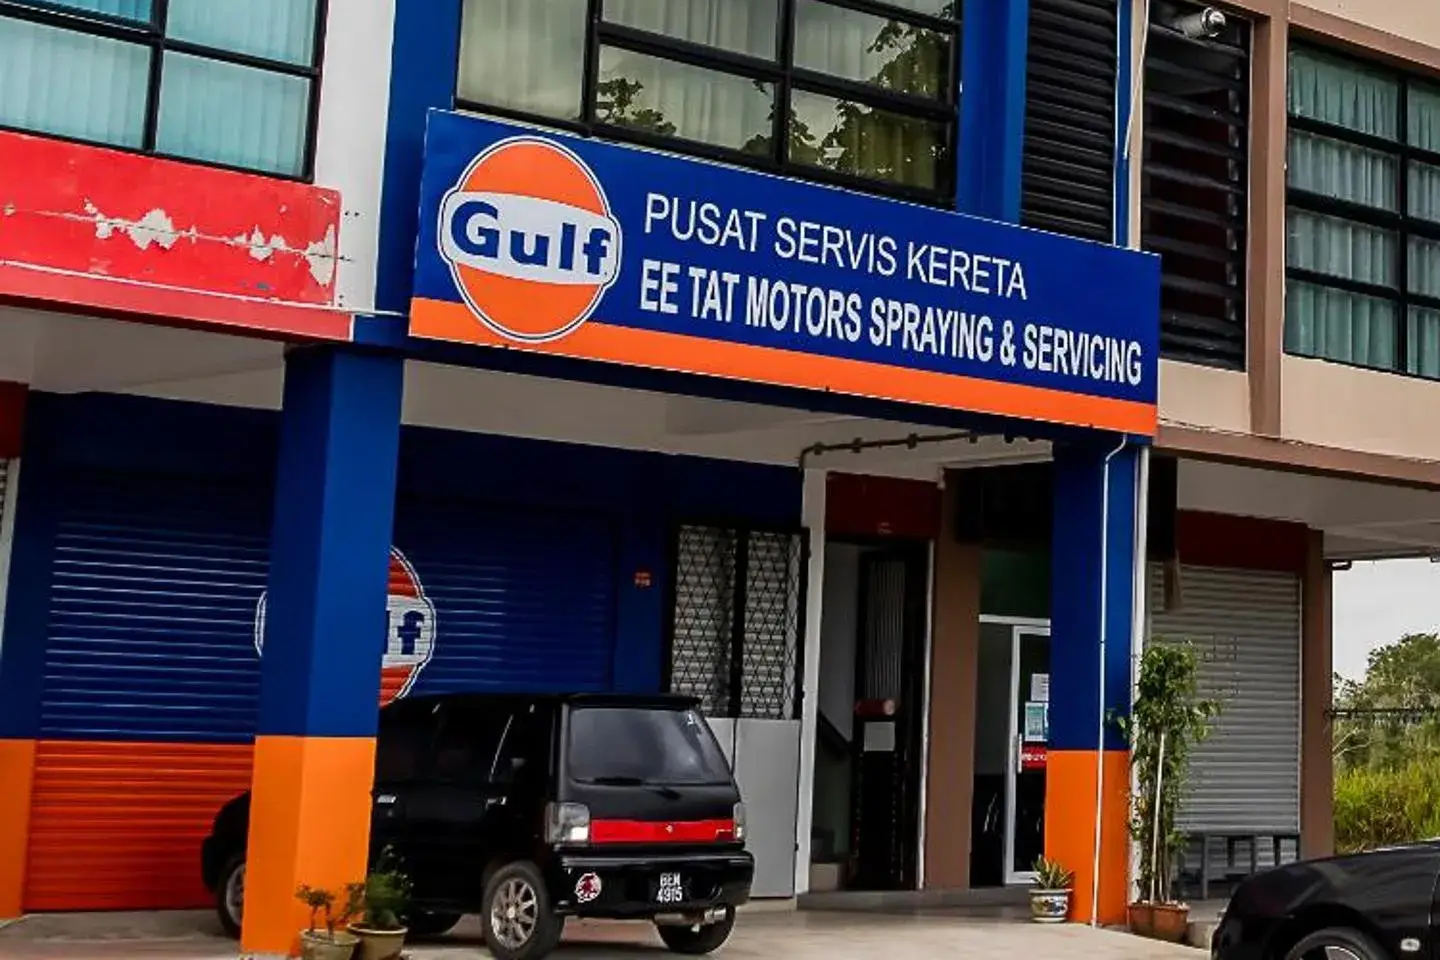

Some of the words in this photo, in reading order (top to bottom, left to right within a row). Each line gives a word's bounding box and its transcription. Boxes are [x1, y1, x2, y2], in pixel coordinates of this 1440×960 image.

[450, 200, 611, 275] Gulf
[645, 192, 767, 253] PUSAT
[775, 217, 898, 277] SERVIS
[907, 241, 1028, 301] KERETA
[640, 259, 681, 314] EE
[688, 266, 740, 323] TAT
[745, 275, 862, 343] MOTORS
[869, 296, 994, 363] SPRAYING
[1000, 319, 1016, 367] &
[1023, 323, 1142, 386] SERVICING
